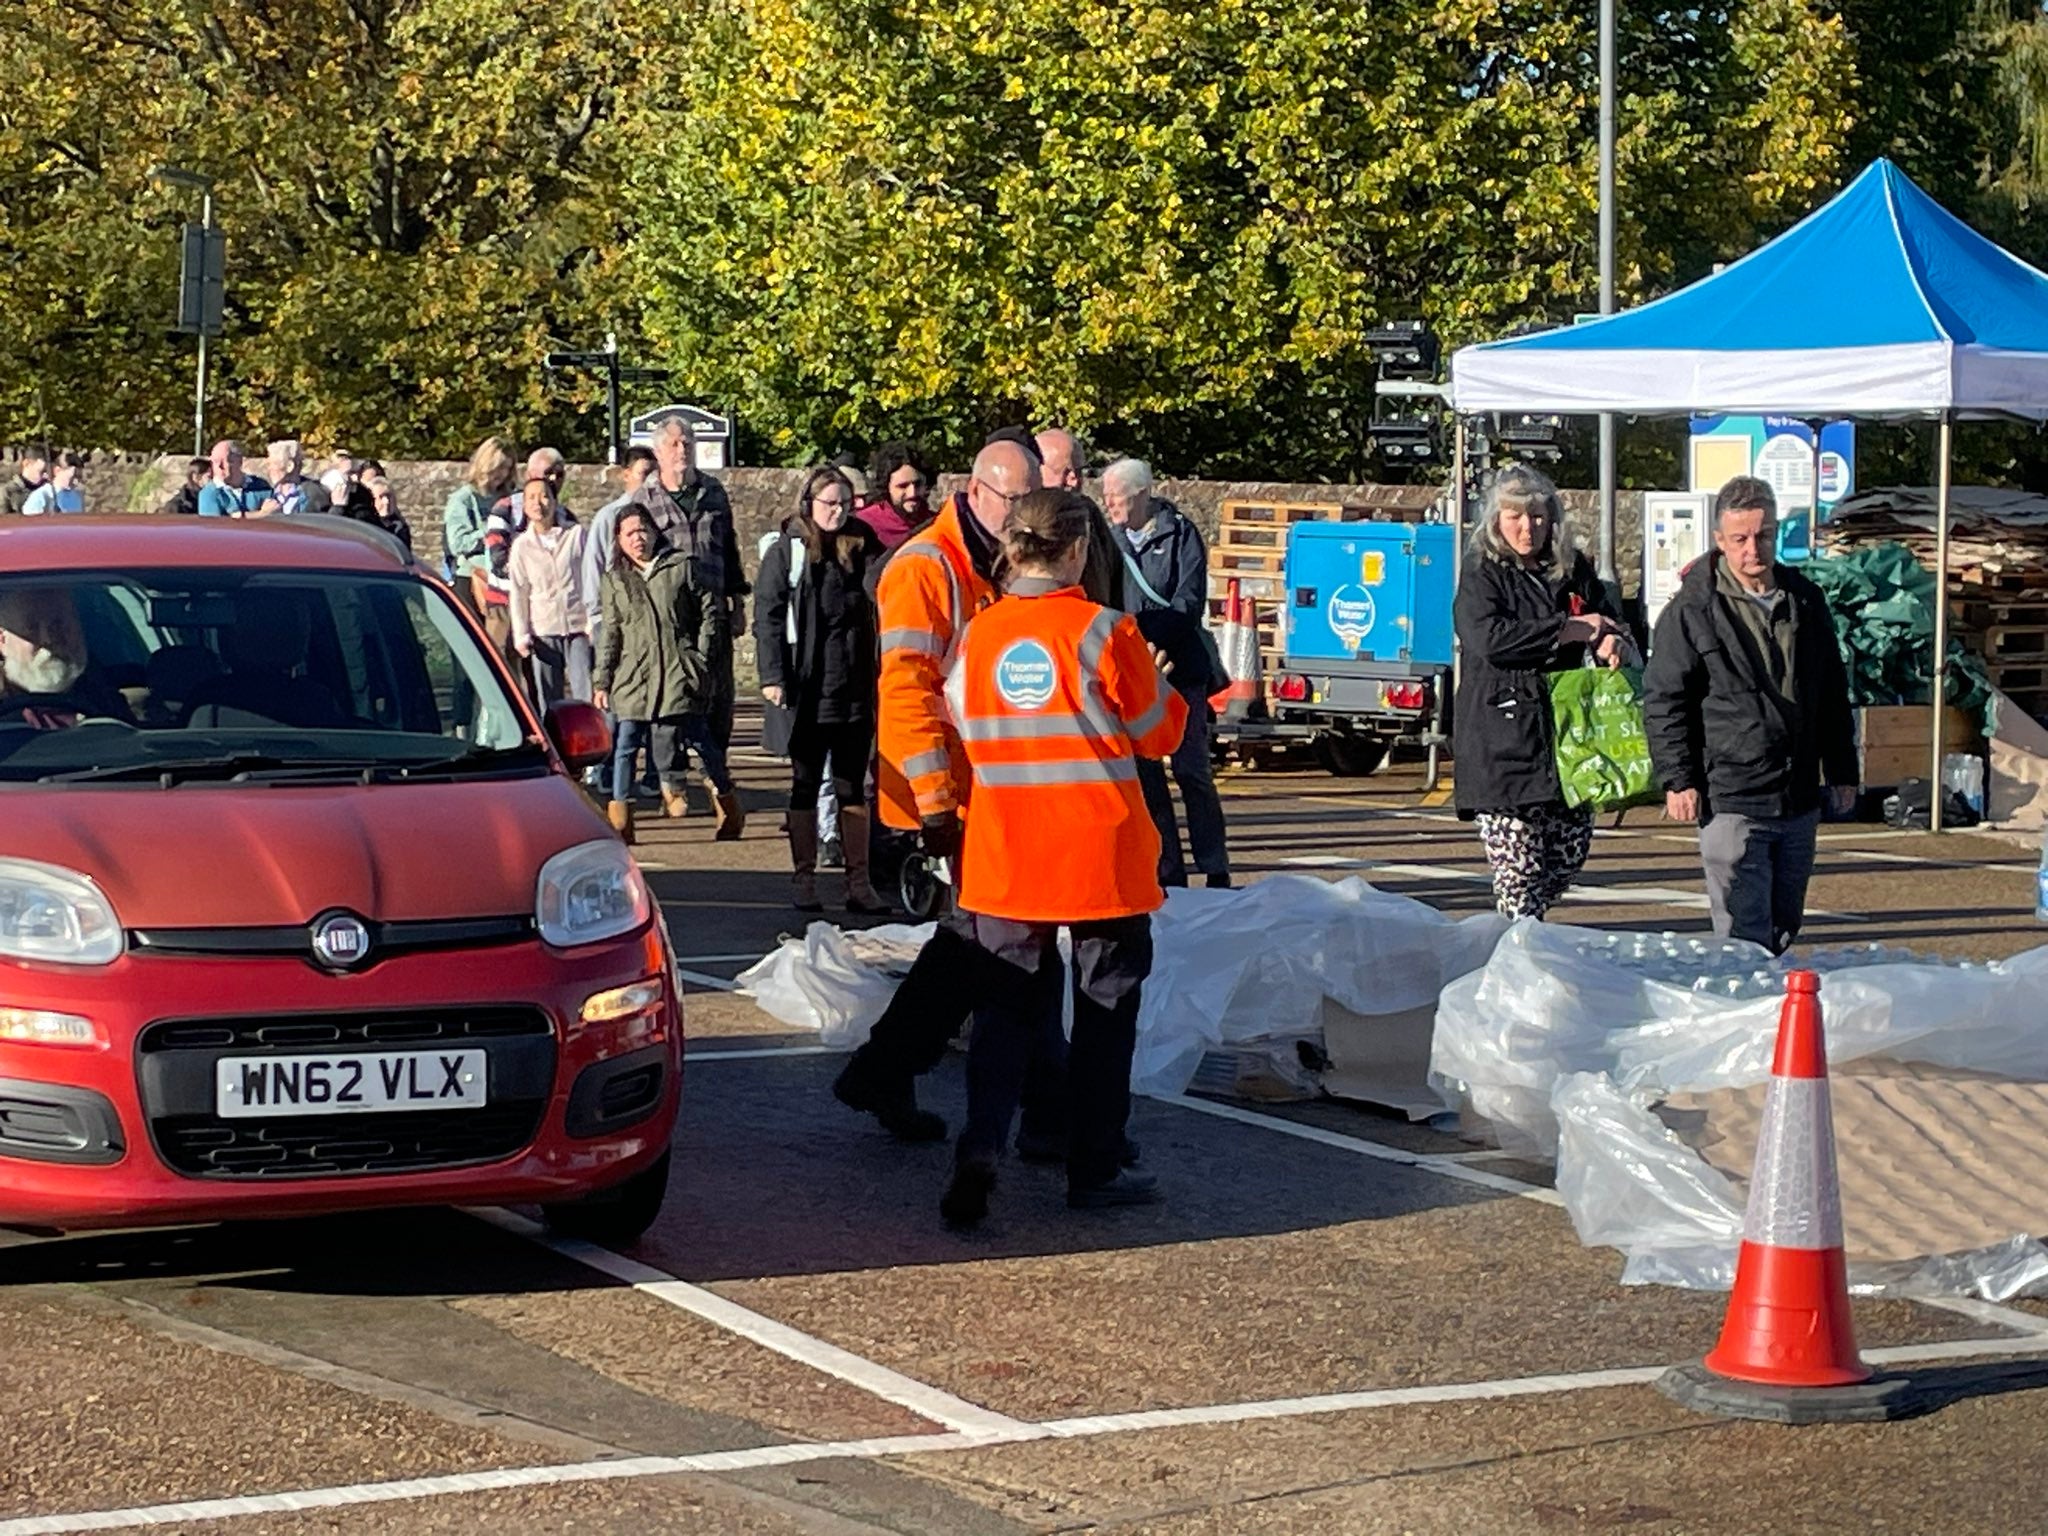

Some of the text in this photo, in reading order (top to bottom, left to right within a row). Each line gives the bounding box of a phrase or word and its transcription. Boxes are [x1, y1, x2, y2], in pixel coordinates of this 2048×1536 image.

[1333, 598, 1371, 611] Thames
[1337, 610, 1367, 621] Water
[1004, 662, 1050, 673] Thames
[1008, 673, 1045, 684] Water
[1620, 721, 1641, 738] SL
[241, 1055, 465, 1106] WN62 VLX
